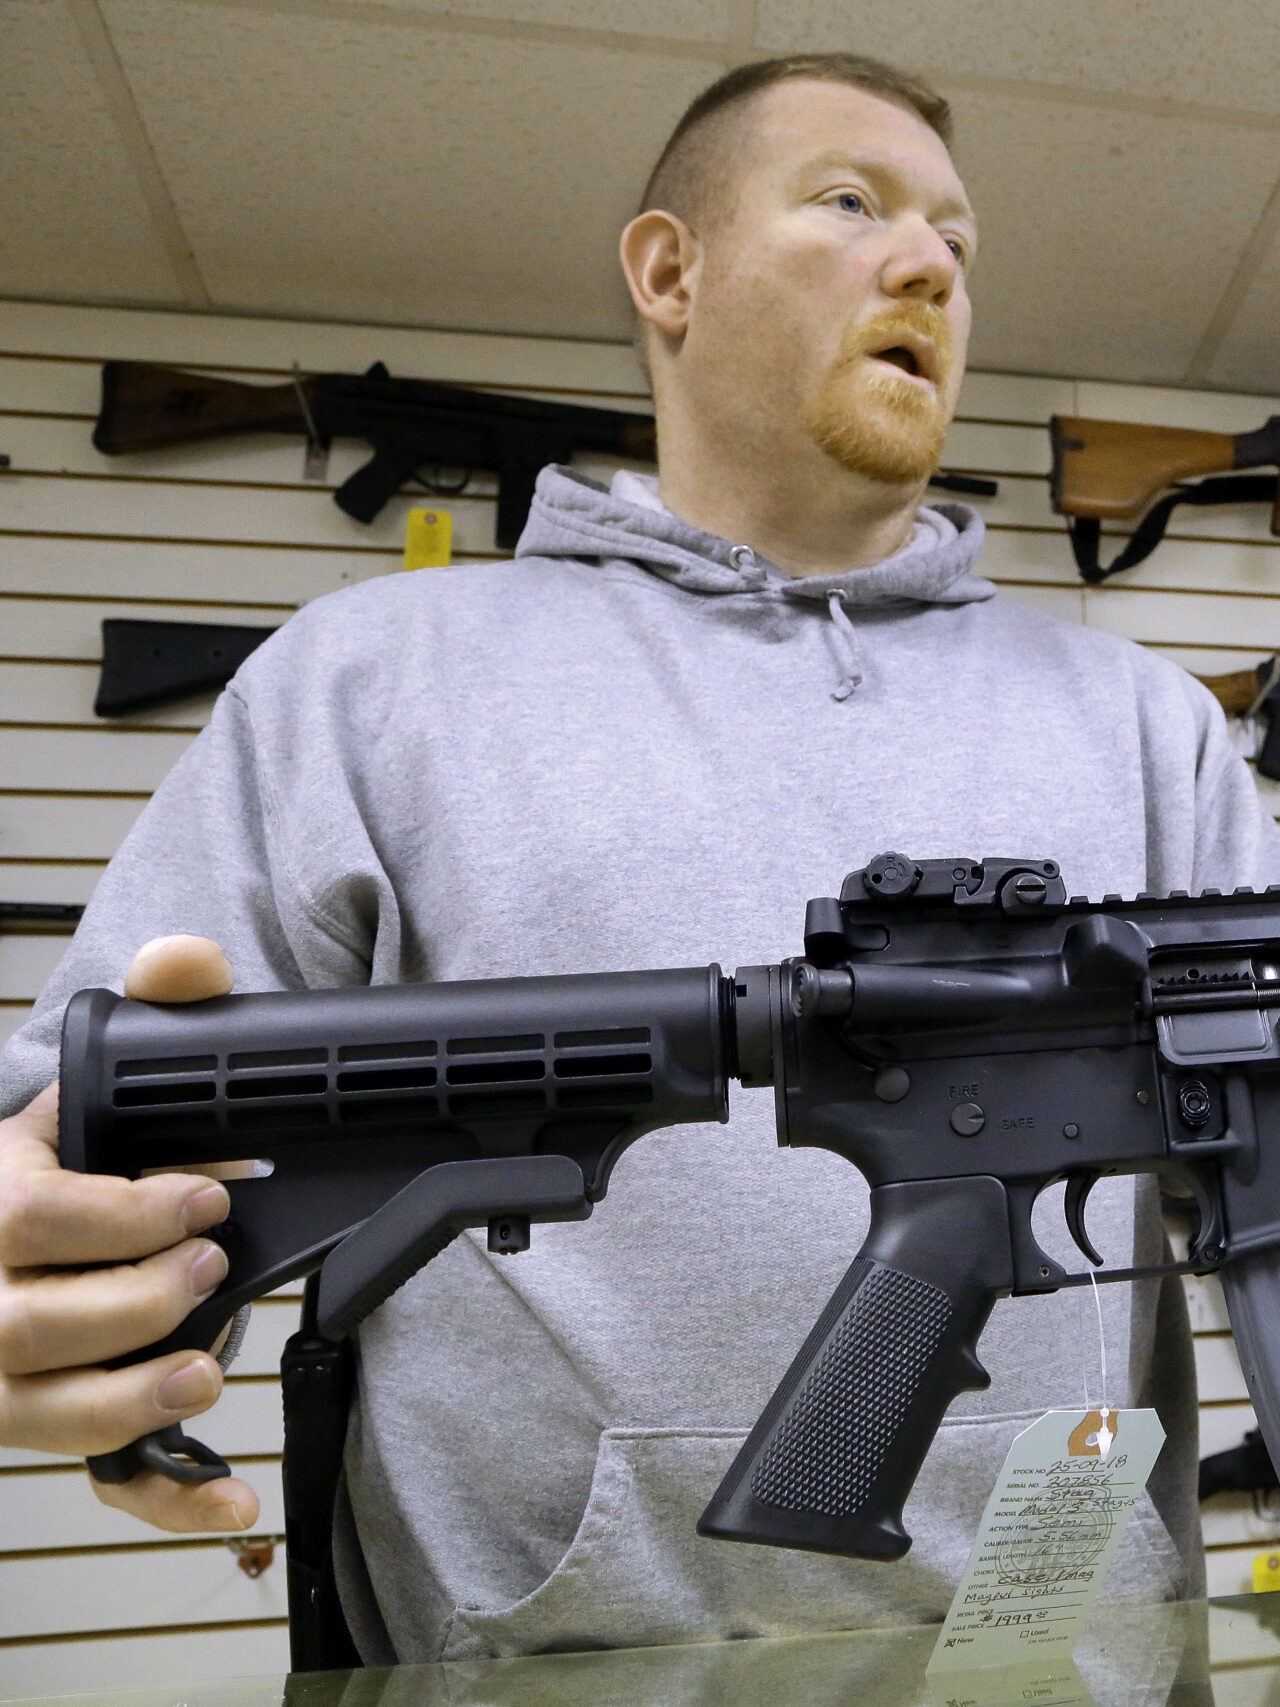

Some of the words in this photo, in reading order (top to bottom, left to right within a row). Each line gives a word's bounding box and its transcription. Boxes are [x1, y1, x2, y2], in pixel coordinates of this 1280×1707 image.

[948, 1083, 980, 1098] FIRE
[1001, 1116, 1036, 1130] SAFE
[994, 1510, 1017, 1518] MODEL
[989, 1525, 1014, 1533] ACTION
[973, 1569, 996, 1577] CHOKE
[967, 1583, 989, 1591] OTHER
[1030, 1628, 1050, 1636] Used
[957, 1637, 975, 1645] New
